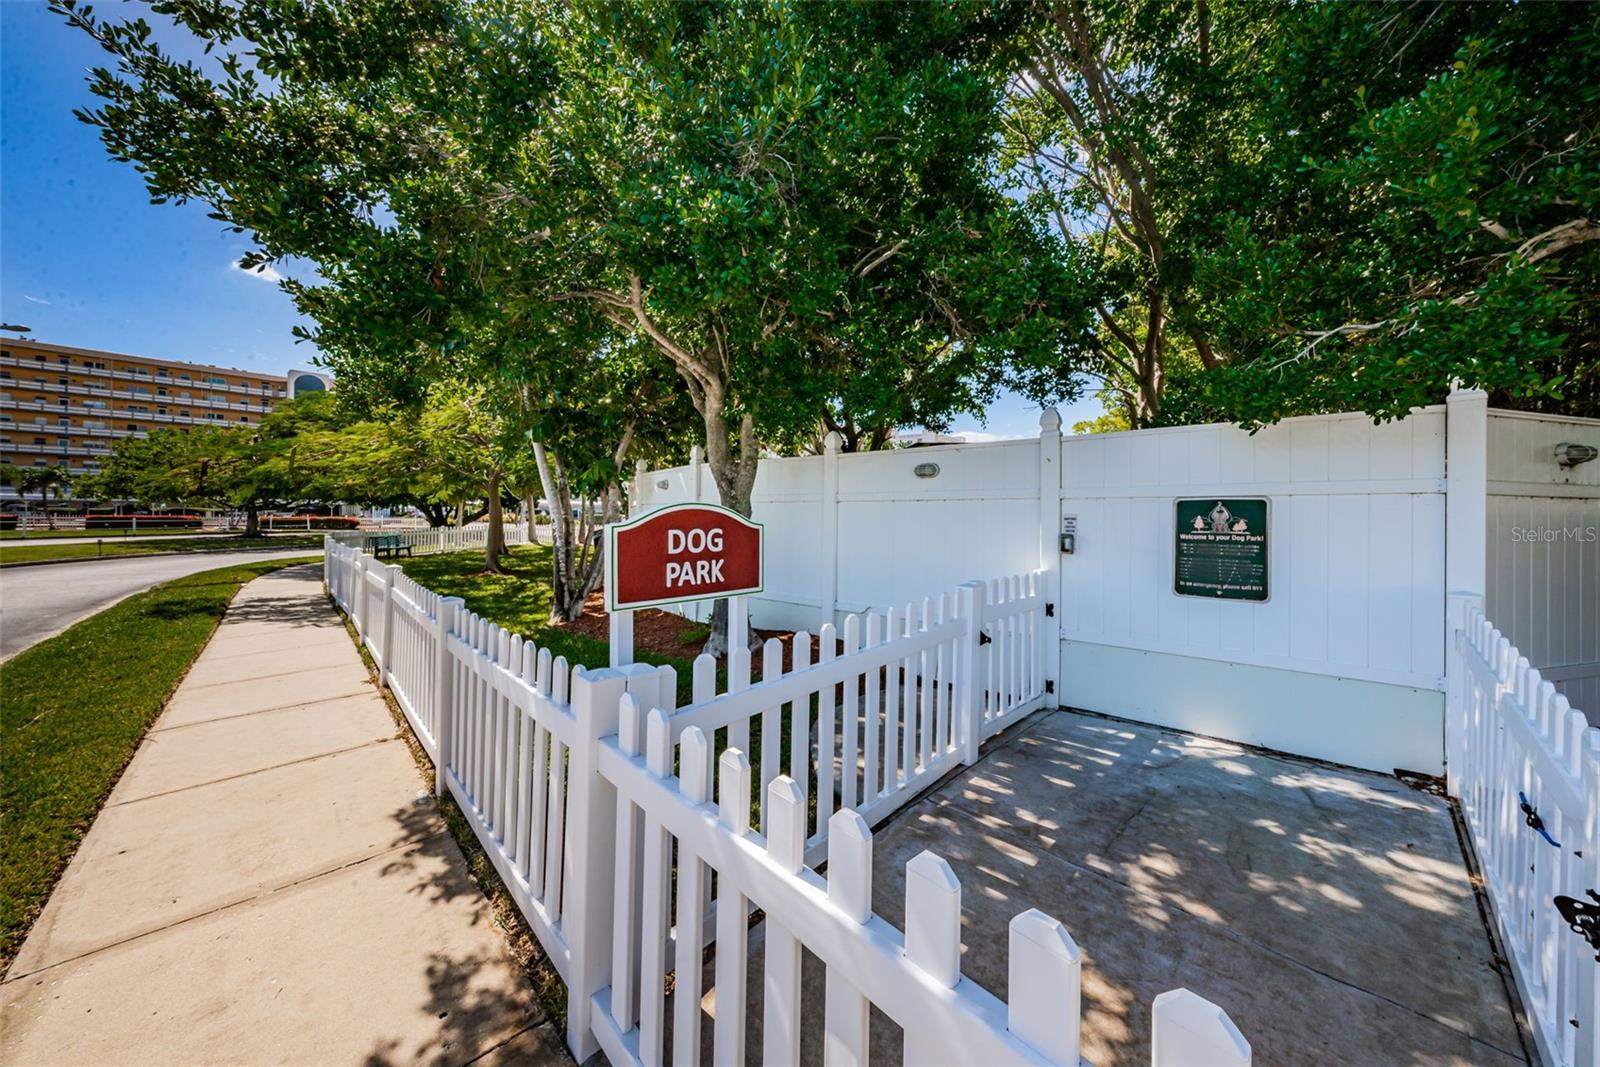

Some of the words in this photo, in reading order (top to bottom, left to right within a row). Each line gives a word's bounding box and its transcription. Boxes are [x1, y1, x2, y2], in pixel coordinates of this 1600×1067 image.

[667, 527, 724, 555] DOG
[1231, 534, 1245, 542] Dog
[666, 558, 725, 588] PARK
